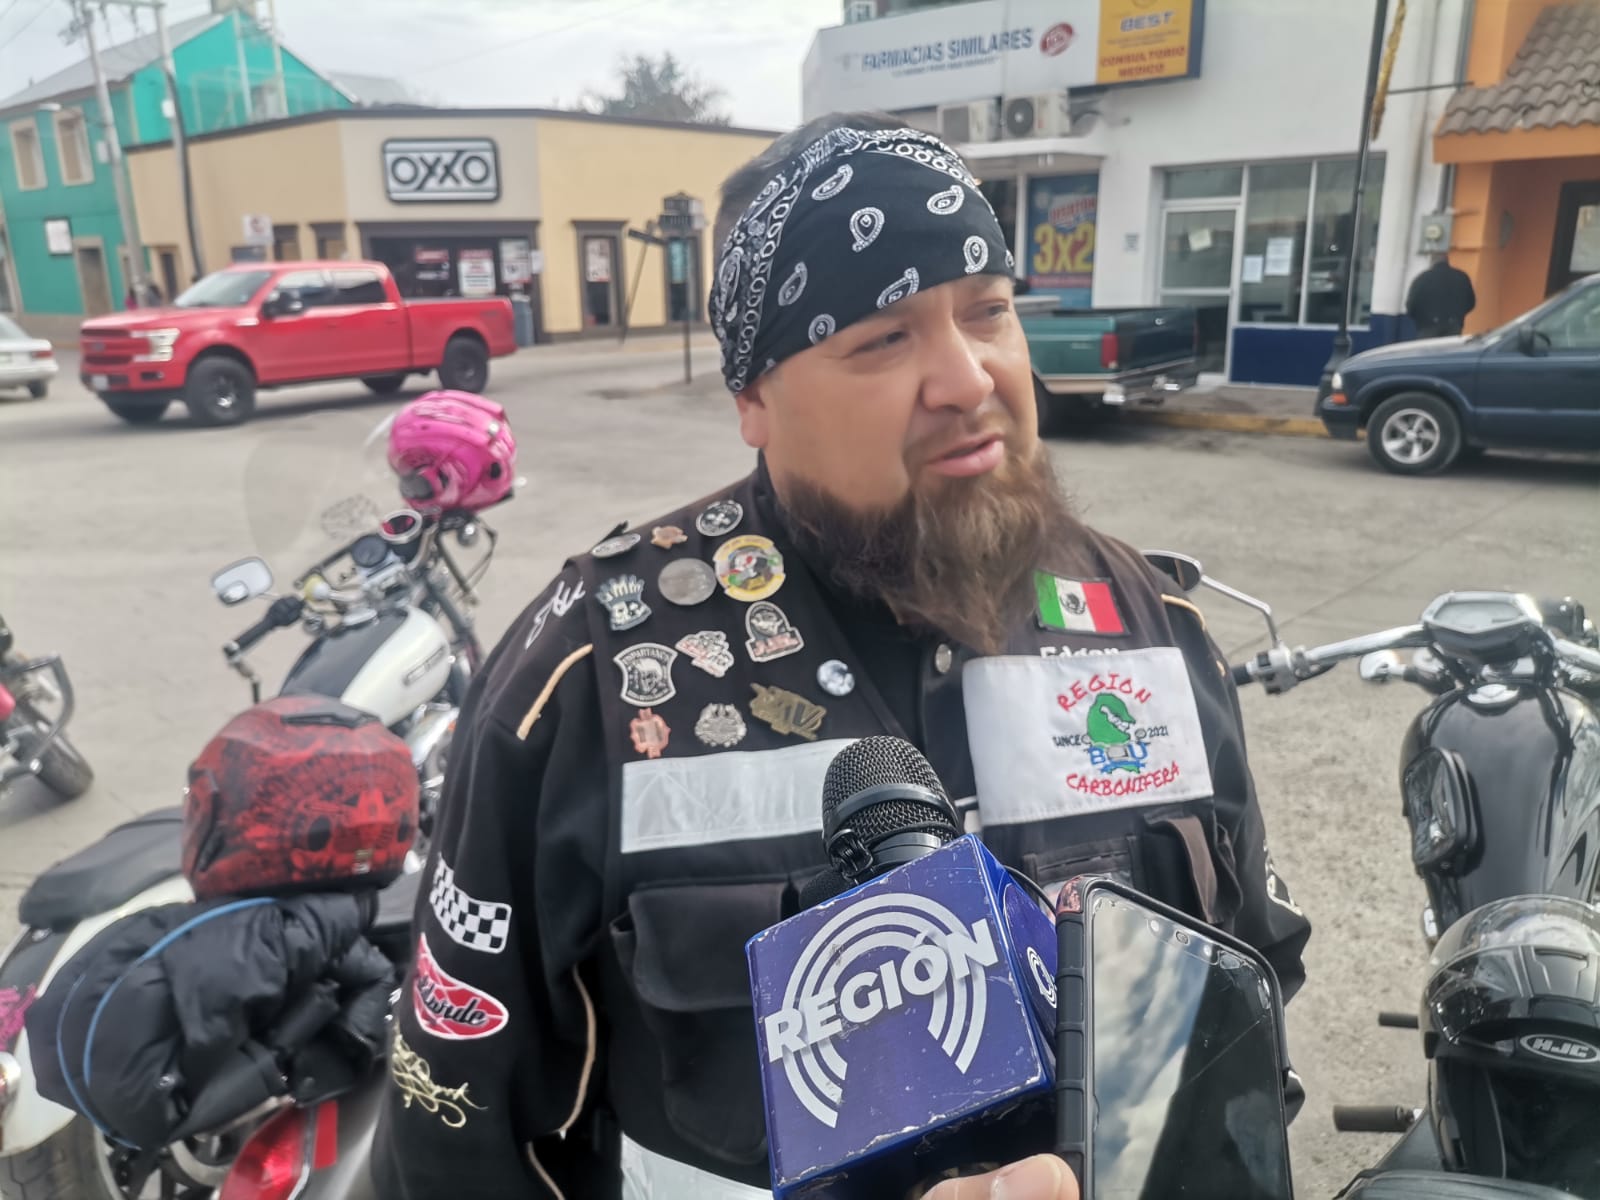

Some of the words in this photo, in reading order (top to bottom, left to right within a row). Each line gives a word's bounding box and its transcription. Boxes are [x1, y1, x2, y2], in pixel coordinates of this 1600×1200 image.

[862, 42, 943, 71] FARMACIAS
[947, 28, 1034, 60] SIMILARES
[391, 150, 490, 190] OXXO
[1056, 673, 1152, 712] REGION
[1066, 760, 1181, 797] CARBONIFERA
[1532, 1038, 1589, 1058] HJC
